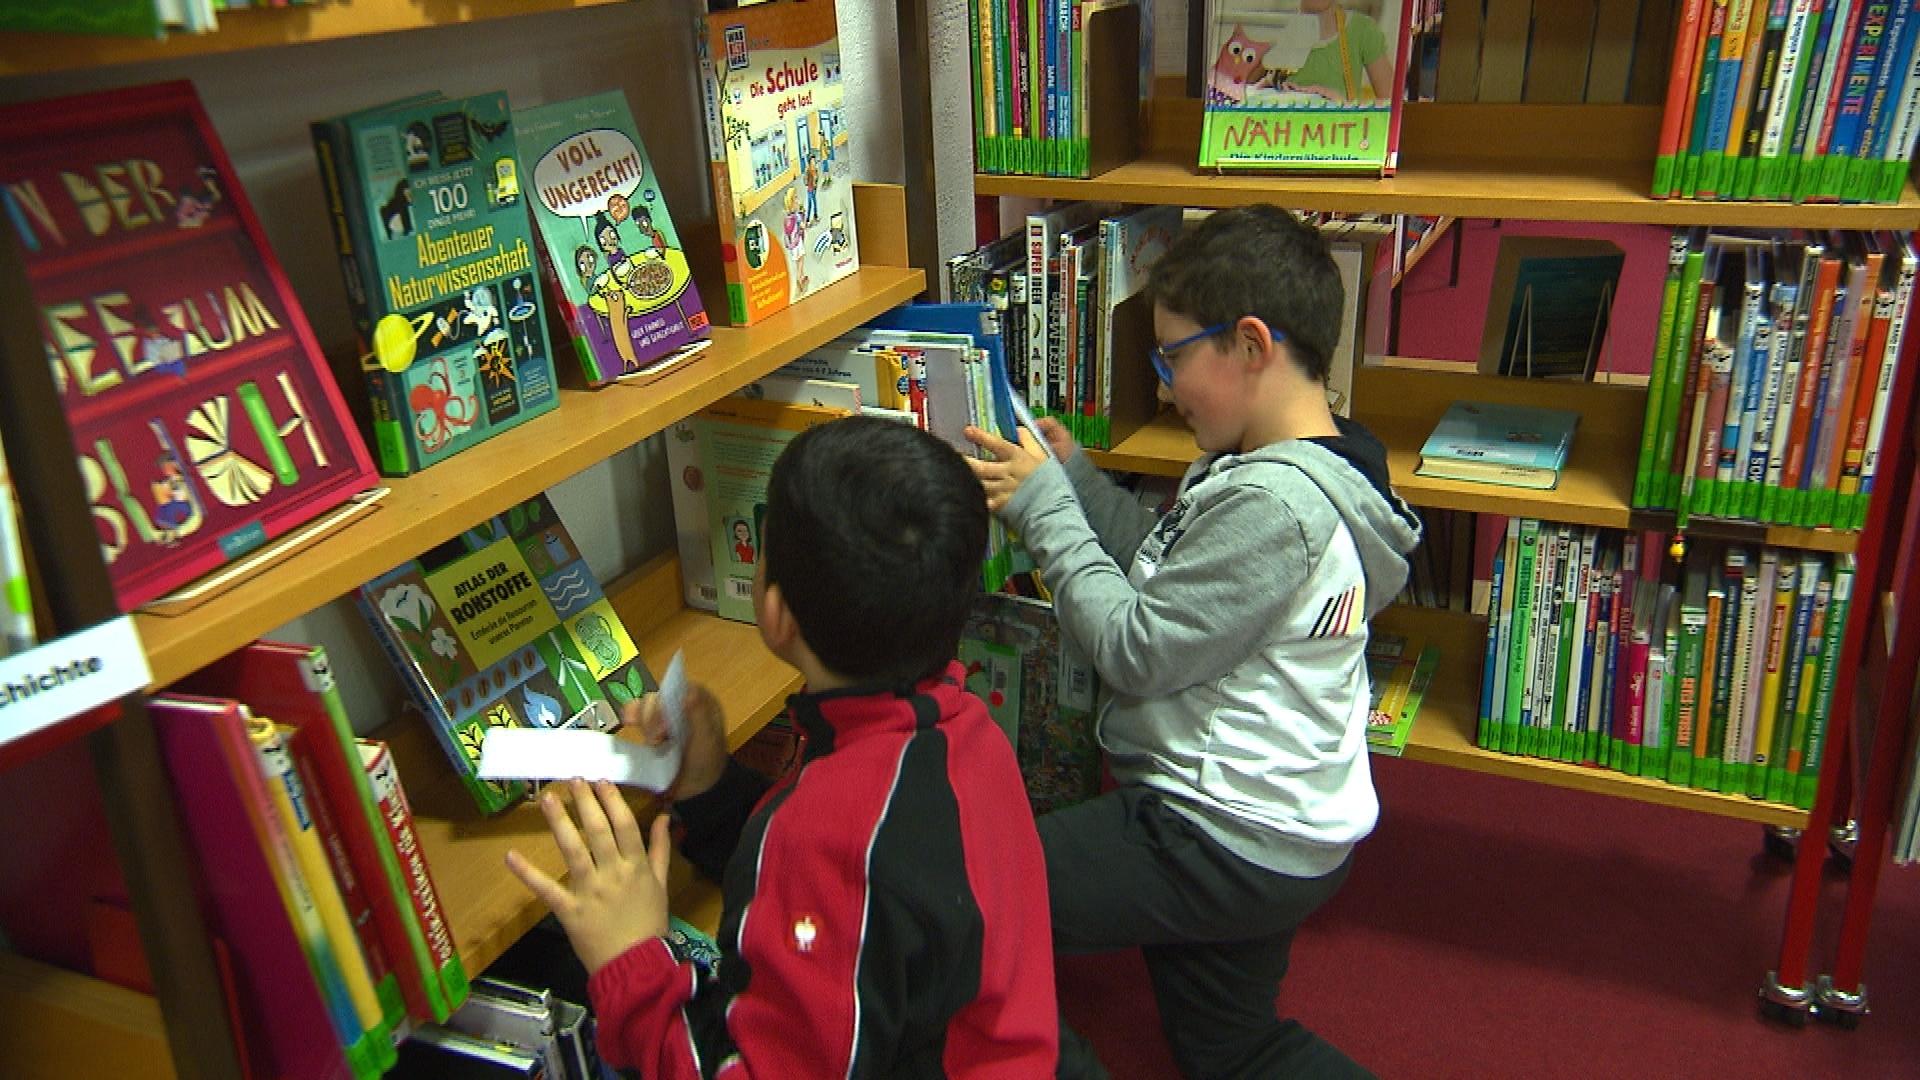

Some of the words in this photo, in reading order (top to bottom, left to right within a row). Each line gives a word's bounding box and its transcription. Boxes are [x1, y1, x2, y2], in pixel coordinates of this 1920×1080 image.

[728, 30, 743, 42] WAS
[731, 53, 746, 67] WAS
[750, 81, 764, 98] Die
[766, 57, 818, 94] Schule
[1841, 4, 1889, 115] EXPERIMENTE
[777, 97, 796, 120] geht
[798, 89, 813, 108] los!
[1223, 115, 1291, 150] NÄH
[1301, 117, 1369, 150] MIT!
[556, 137, 602, 172] VOLL
[61, 159, 177, 236] DER
[428, 183, 468, 214] 100
[543, 152, 641, 210] UNGERECHT!
[417, 225, 494, 268] Abenteuer
[388, 238, 532, 310] Naturwissenschaft
[450, 571, 532, 624] ROHSTOFFE
[454, 573, 486, 598] ATLAS
[485, 561, 509, 581] DER
